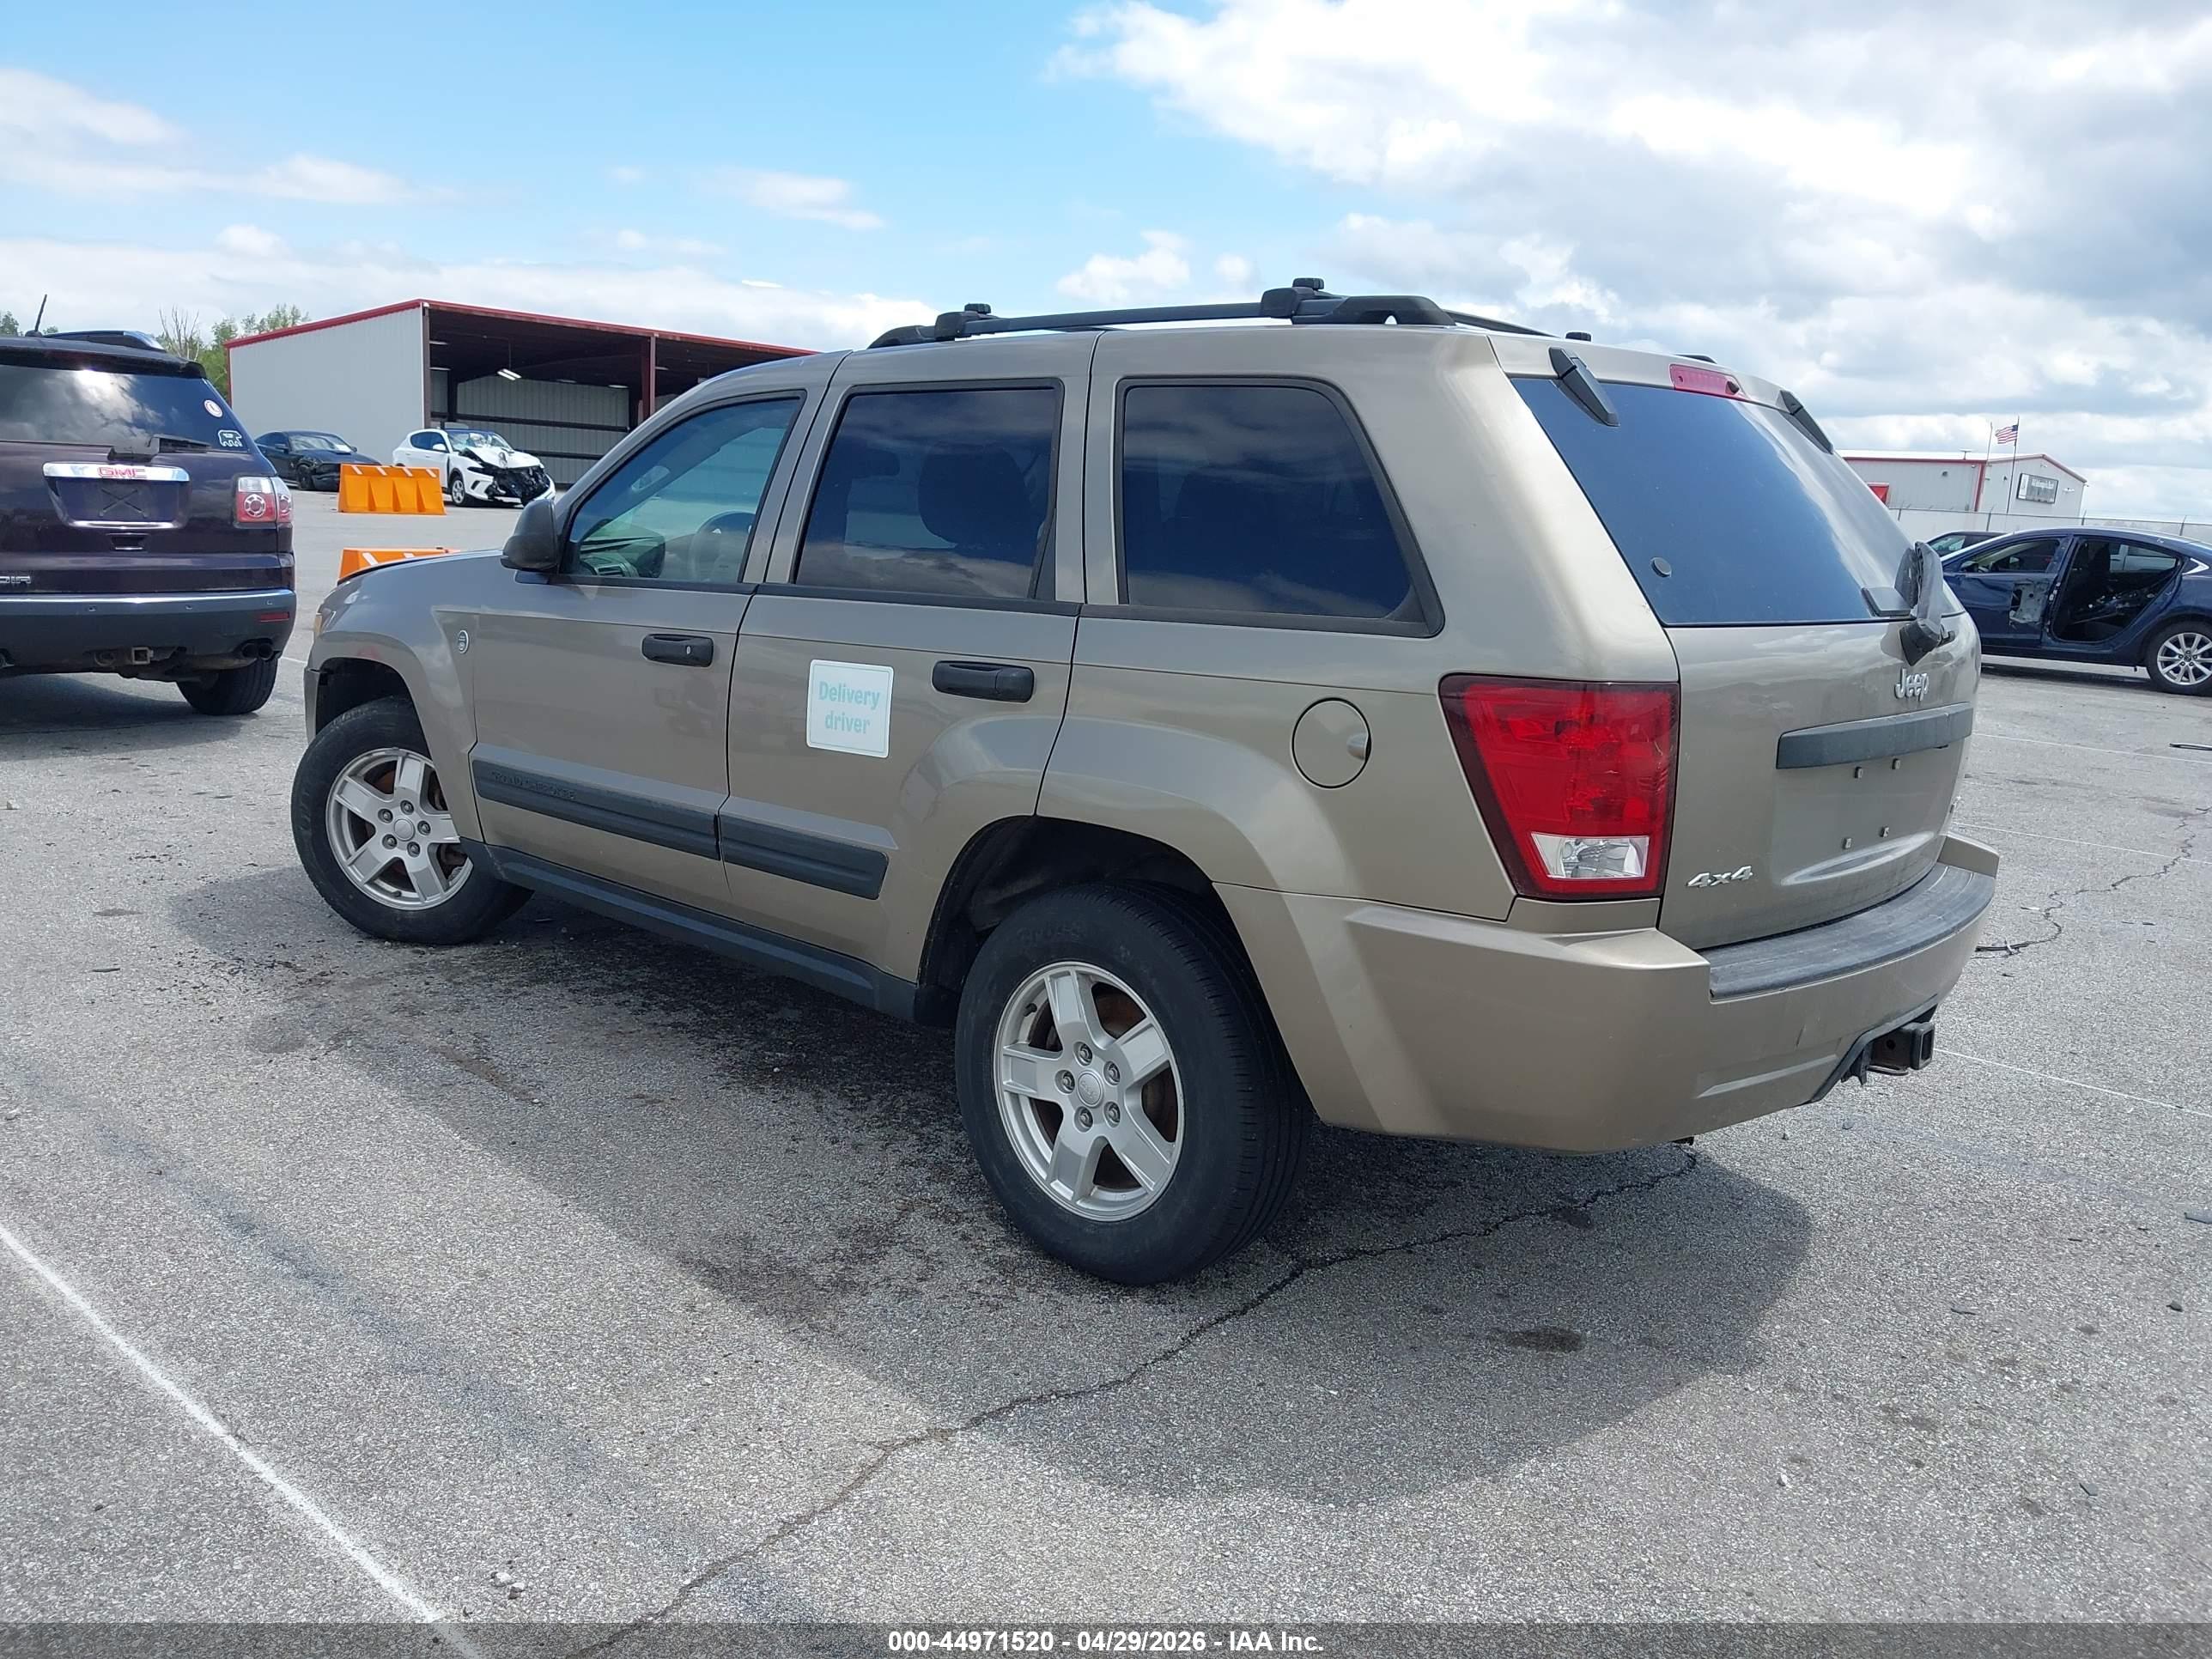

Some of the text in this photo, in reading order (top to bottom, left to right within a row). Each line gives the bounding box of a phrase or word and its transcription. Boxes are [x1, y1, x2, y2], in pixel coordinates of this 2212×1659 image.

[97, 466, 147, 478] GMC
[818, 681, 880, 710] Delivery
[1894, 668, 1929, 702] Jeep
[825, 710, 870, 734] driver
[1687, 866, 1753, 887] 4x4
